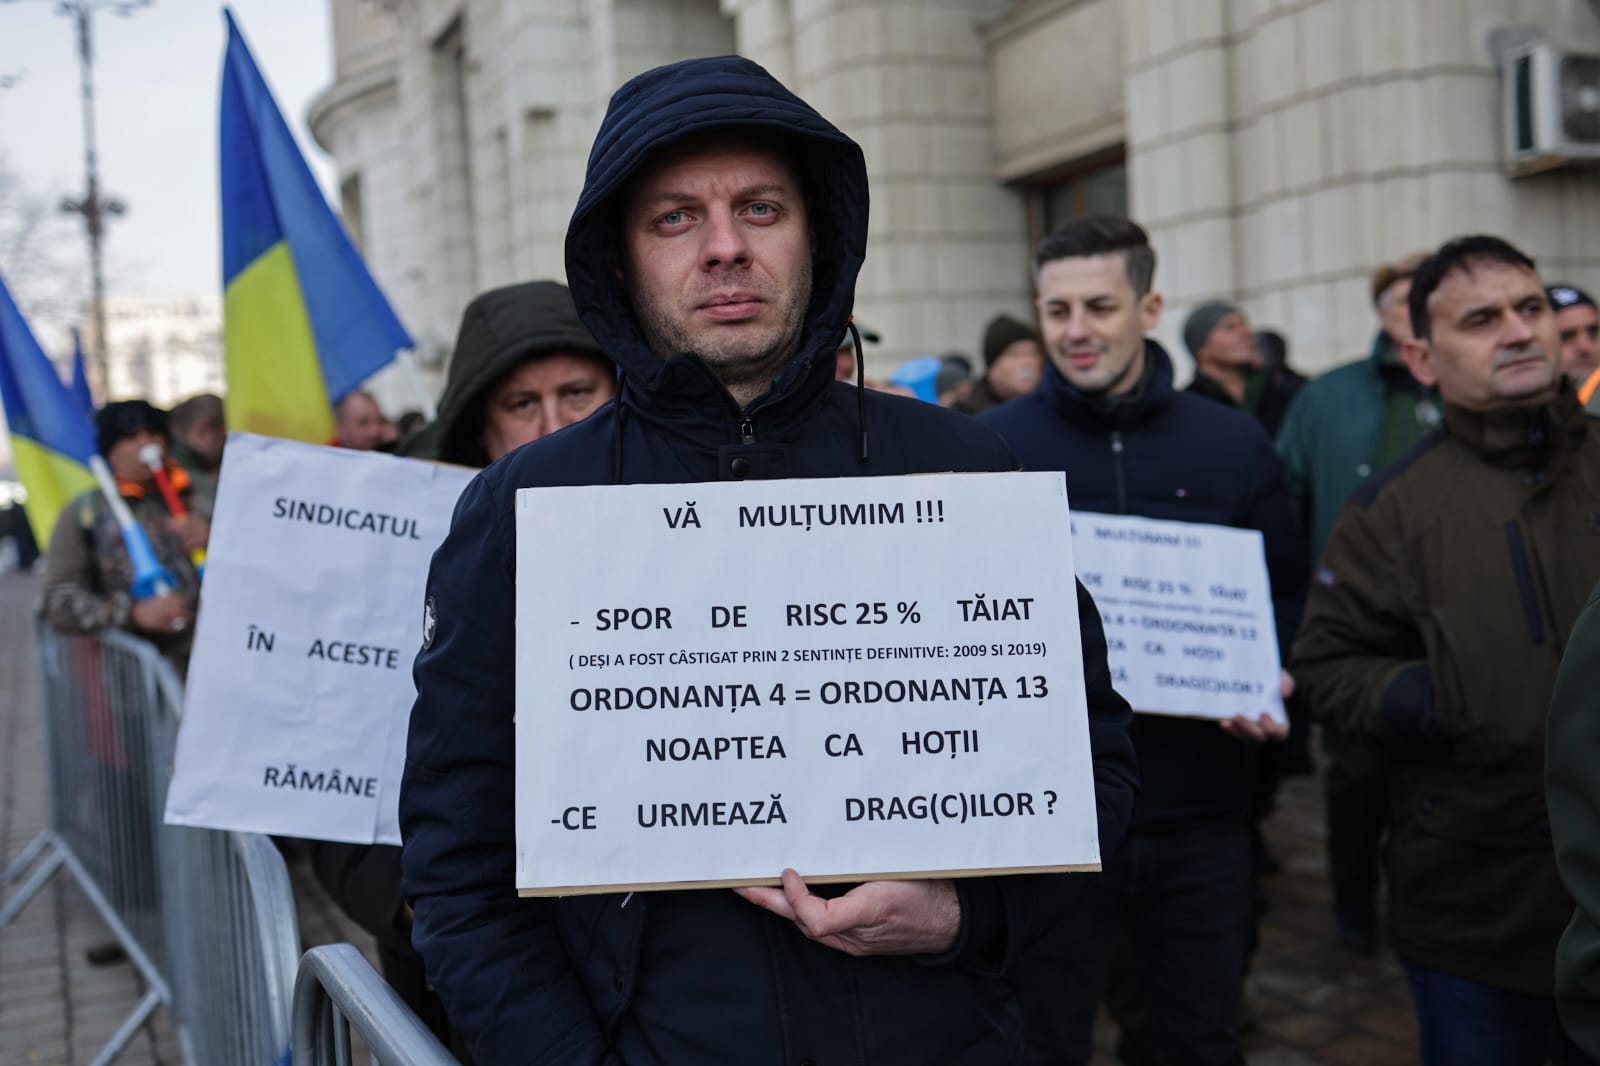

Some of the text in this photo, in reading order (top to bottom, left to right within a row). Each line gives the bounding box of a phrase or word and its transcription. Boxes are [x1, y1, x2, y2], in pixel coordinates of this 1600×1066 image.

[273, 497, 420, 540] SINDICATUL
[662, 500, 702, 529] VĂ
[738, 502, 905, 532] MULȚUMIM
[595, 607, 673, 632] SPOR
[711, 605, 748, 629] DE
[786, 602, 847, 627] RISC
[855, 602, 888, 625] 25
[896, 600, 921, 625] %
[956, 592, 1035, 622] TĂIAT
[247, 625, 399, 670] ÎN ACESTE
[578, 654, 610, 670] DEȘI
[613, 654, 625, 666] A
[629, 652, 665, 666] FOST
[668, 649, 739, 665] CÂSTIGAT
[742, 650, 777, 663] PRIN
[781, 649, 790, 662] 2
[793, 648, 863, 663] SENTINȚE
[866, 645, 949, 660] DEFINITIVE:
[953, 644, 987, 658] 2009
[990, 644, 1003, 657] SI
[1007, 641, 1047, 658] 2019)
[570, 675, 1049, 714] ORDONANȚA 4 = ORDONANȚA 13
[646, 729, 979, 763] NOAPTEA CA HOȚII
[263, 764, 377, 798] RĂMÂNE
[551, 790, 1058, 831] -CE URMEAZĂ DRAG(C)ILOR ?
